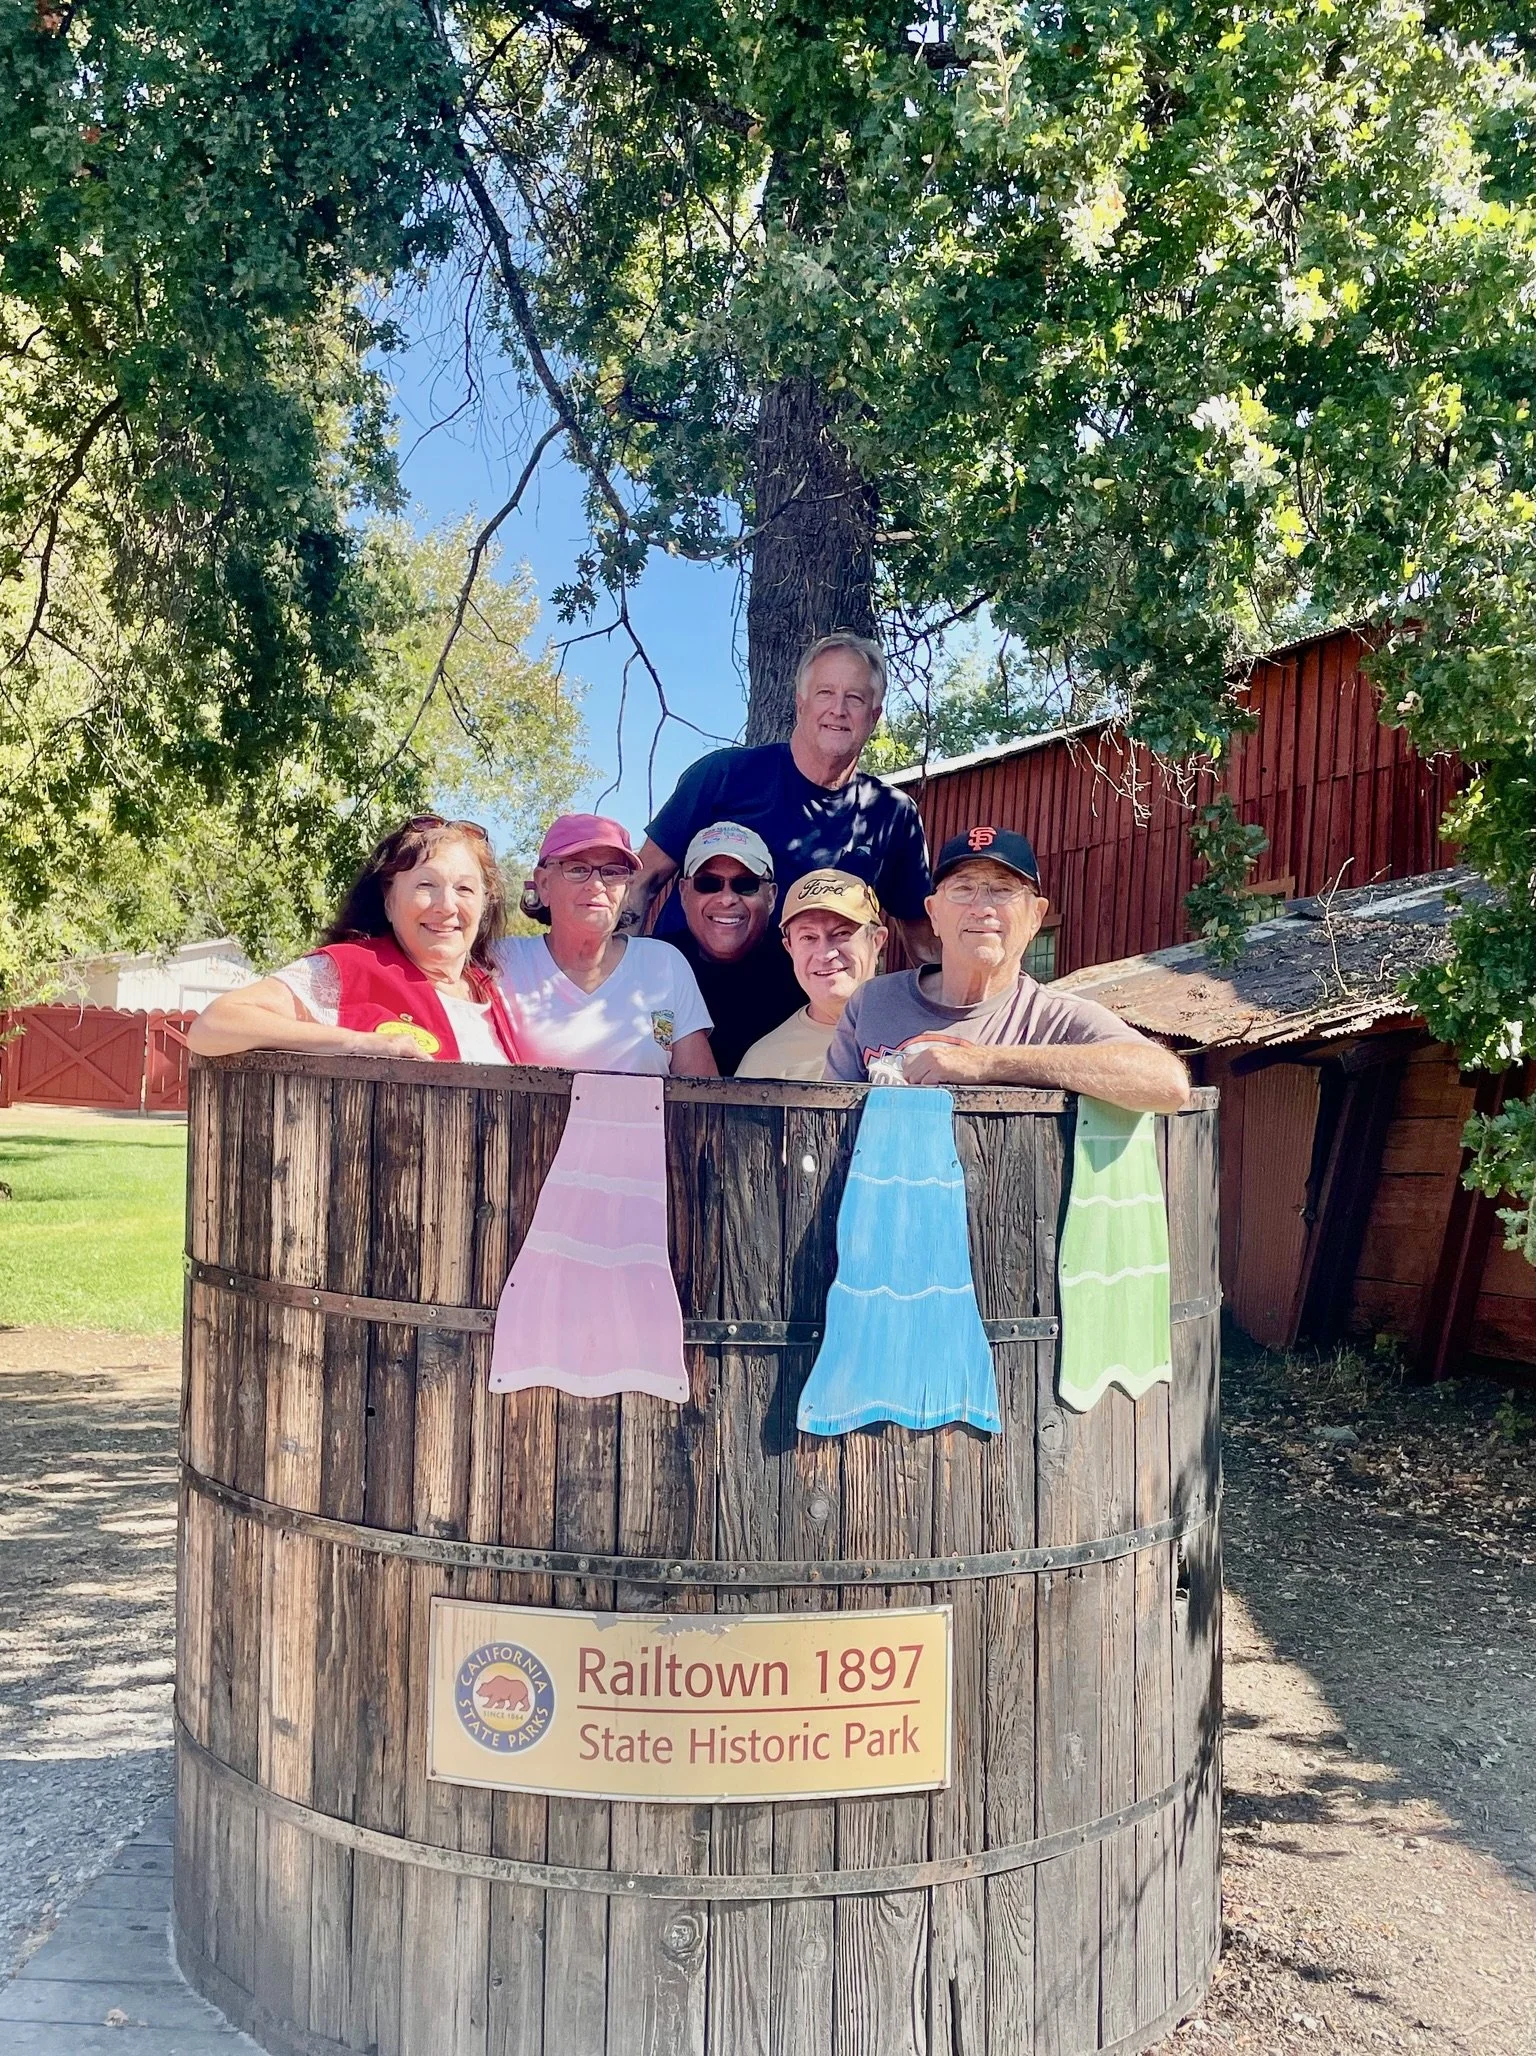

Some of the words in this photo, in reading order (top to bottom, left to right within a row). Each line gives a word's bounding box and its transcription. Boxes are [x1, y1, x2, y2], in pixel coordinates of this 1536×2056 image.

[968, 826, 997, 851] SF
[797, 878, 848, 900] Ford
[460, 1646, 549, 1694] CALIFORNIA
[578, 1645, 789, 1698] Railtown
[815, 1644, 925, 1694] 1897
[459, 1699, 500, 1747] STATE
[508, 1706, 549, 1748] PARKS
[579, 1723, 673, 1764] State
[689, 1722, 830, 1764] Historic
[844, 1714, 921, 1759] Park
